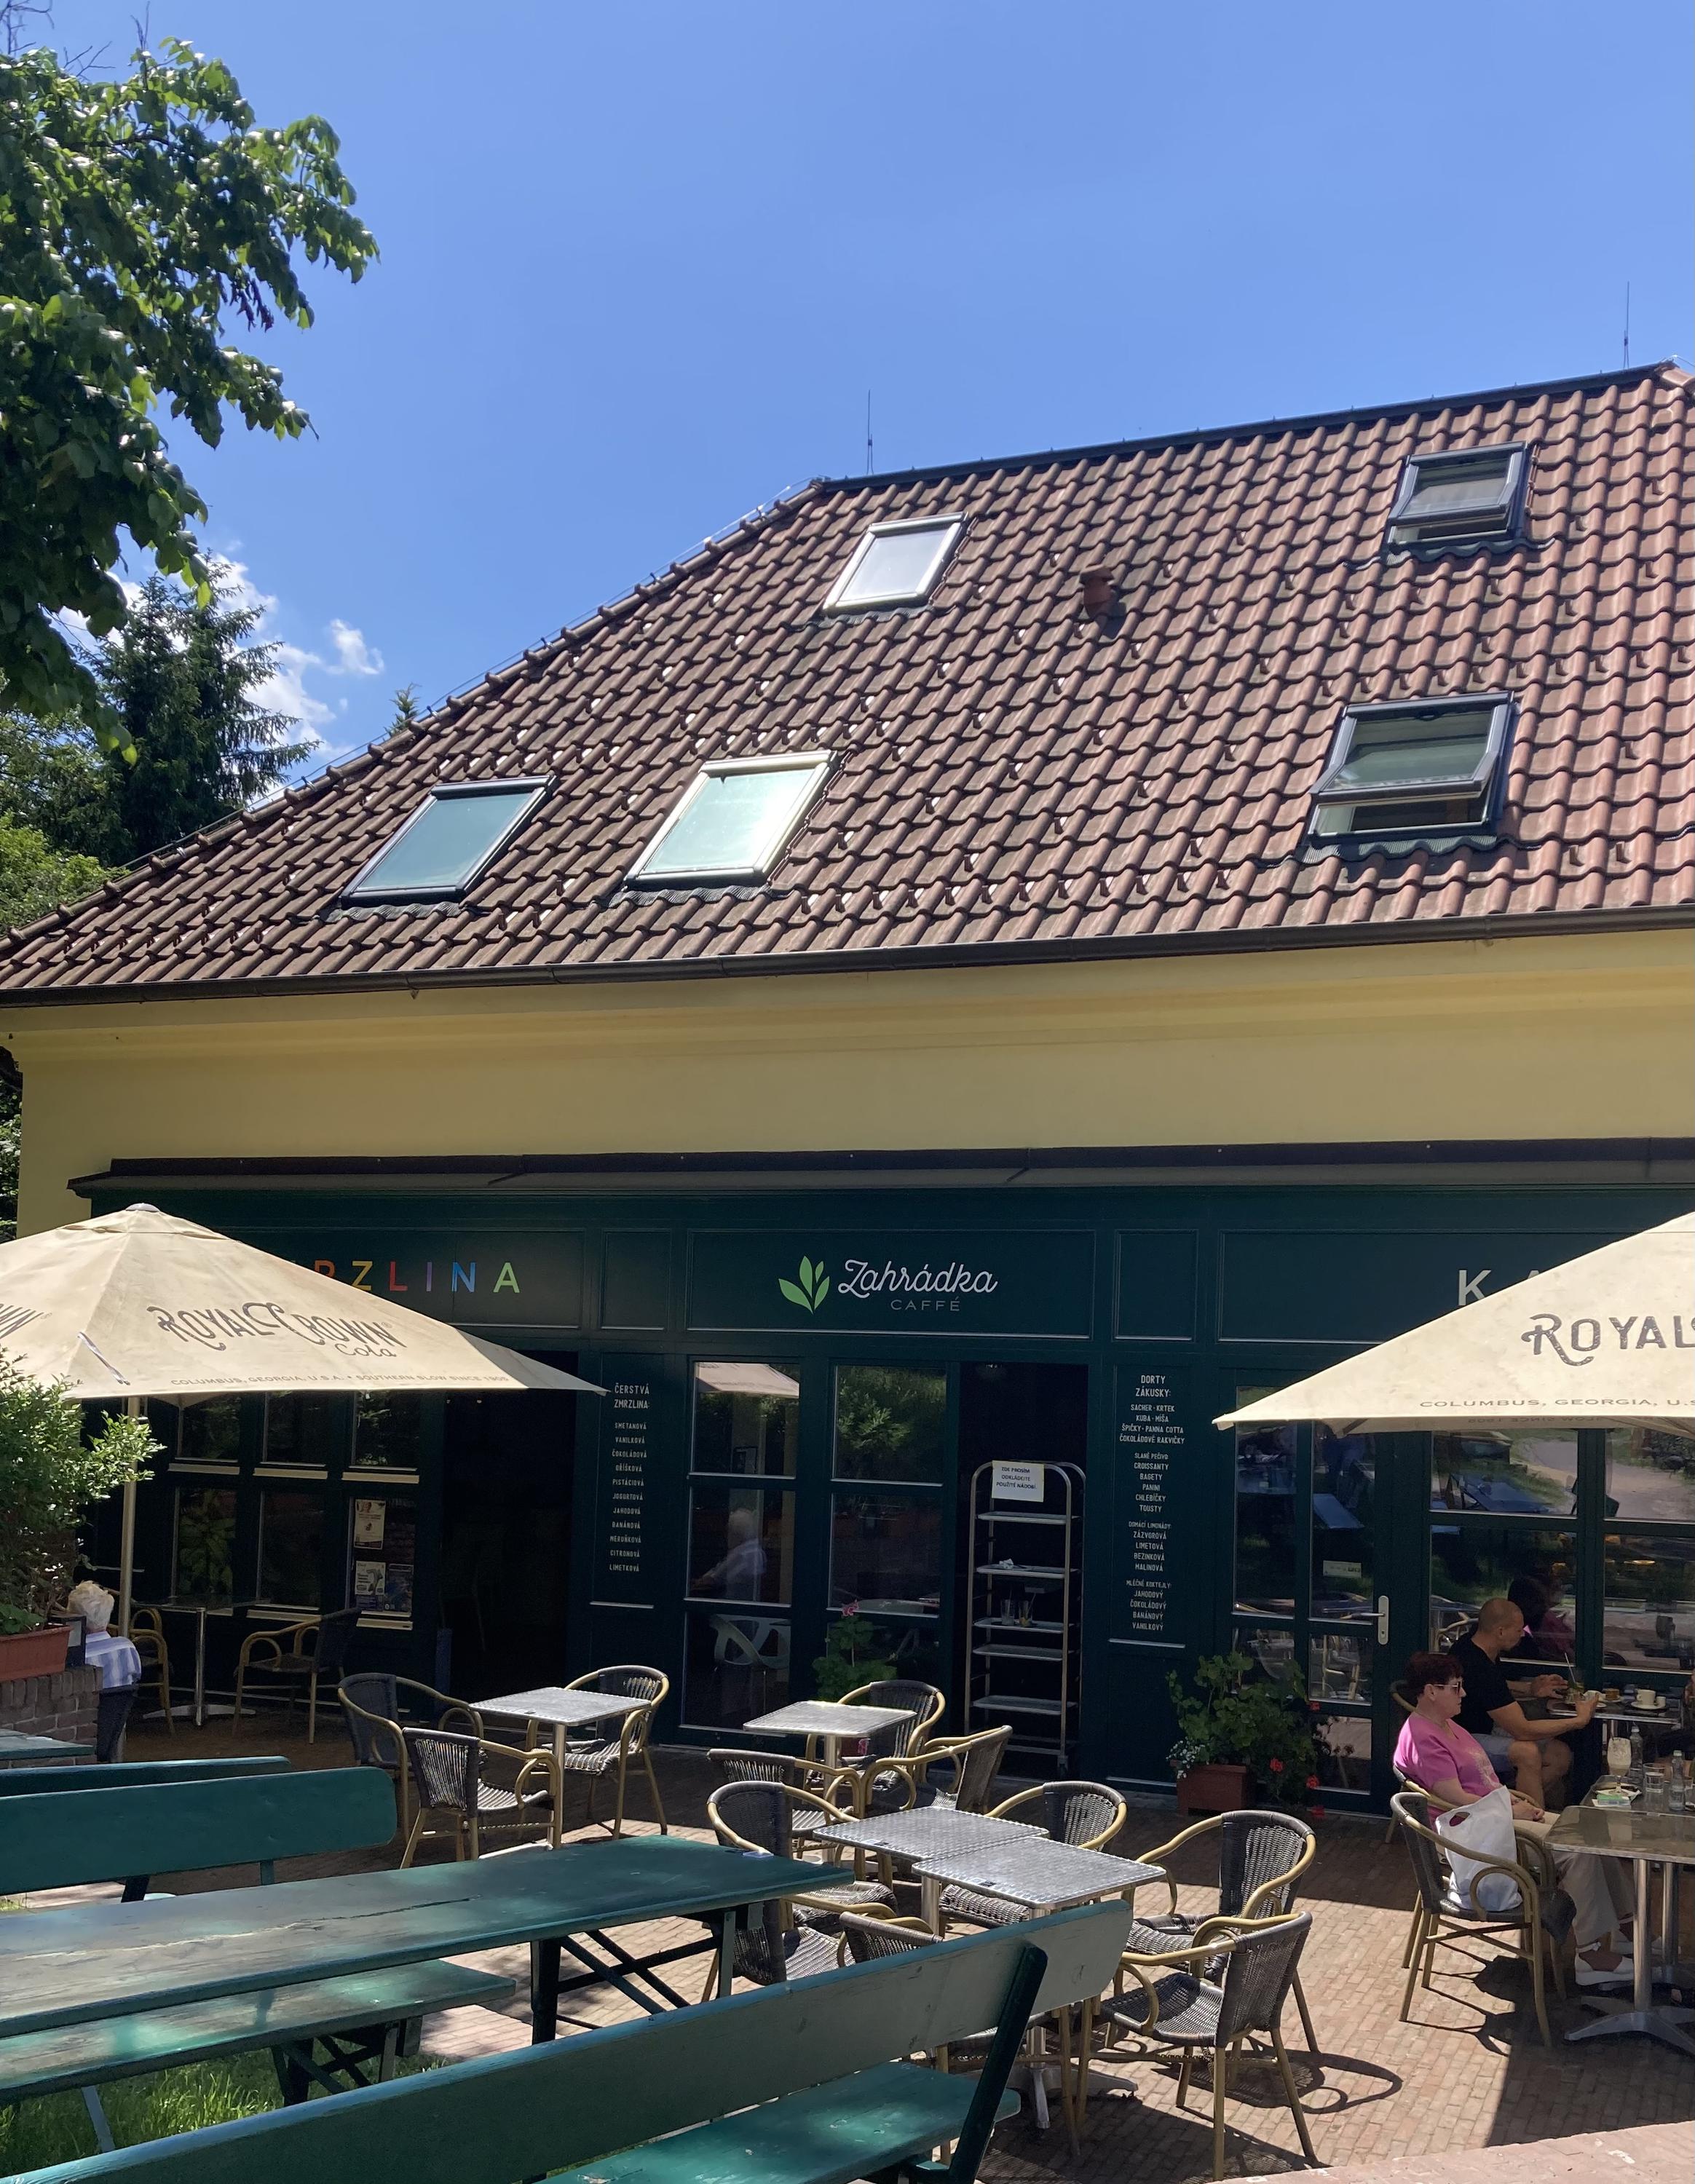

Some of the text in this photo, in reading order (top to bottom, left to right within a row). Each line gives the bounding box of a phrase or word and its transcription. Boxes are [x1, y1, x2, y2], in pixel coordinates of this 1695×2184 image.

[838, 1259, 998, 1298] Zahrádka
[890, 1296, 960, 1310] CAFFÉ
[146, 1305, 274, 1351] ROYAL
[335, 1343, 397, 1358] Cola
[170, 1377, 247, 1385] COLUMBUS,
[1140, 1374, 1166, 1384] DORTY
[615, 1382, 649, 1394] ČERSTVÁ
[1135, 1385, 1172, 1397] ZÁKUSKY:
[1420, 1399, 1547, 1407] COLUMBUS,
[1554, 1398, 1659, 1407] GEORGIA,
[1155, 1414, 1169, 1423] MÍŠA
[615, 1422, 647, 1430] SMETANOVÁ
[1121, 1423, 1142, 1432] ŠPIČKY
[1119, 1433, 1185, 1444] ČOKOLÁDOVÉ RAKVIČKY
[612, 1449, 647, 1457] ČOKOLÁDOVÁ
[615, 1463, 642, 1472] OŘÍŠKOVÁ
[1134, 1462, 1169, 1471] CROISSANTY
[612, 1477, 644, 1486] PISTÁCIOVÁ
[1139, 1473, 1163, 1481] BAGETY
[1135, 1492, 1166, 1502] CHLEBÍČKY
[1139, 1504, 1162, 1512] TOUSTY
[612, 1520, 641, 1529] BANÁNOVÁ
[610, 1535, 641, 1543] MERUŇKOVÁ
[1133, 1530, 1167, 1540] ZÁZVOROVÁ
[1136, 1541, 1163, 1550] LIMETOVÁ
[610, 1549, 640, 1557] CITRONOVÁ
[1134, 1552, 1165, 1561] BEZINKOVÁ
[609, 1563, 639, 1572] LIMETKOVÁ
[1135, 1563, 1163, 1572] MALINOVÁ
[1134, 1590, 1163, 1599] JAHODOVÝ
[1130, 1599, 1167, 1610] ČOKOLÁDOVÝ
[1133, 1611, 1163, 1620] BANÁNOVÝ
[1132, 1622, 1163, 1631] VANILKOVÝ
